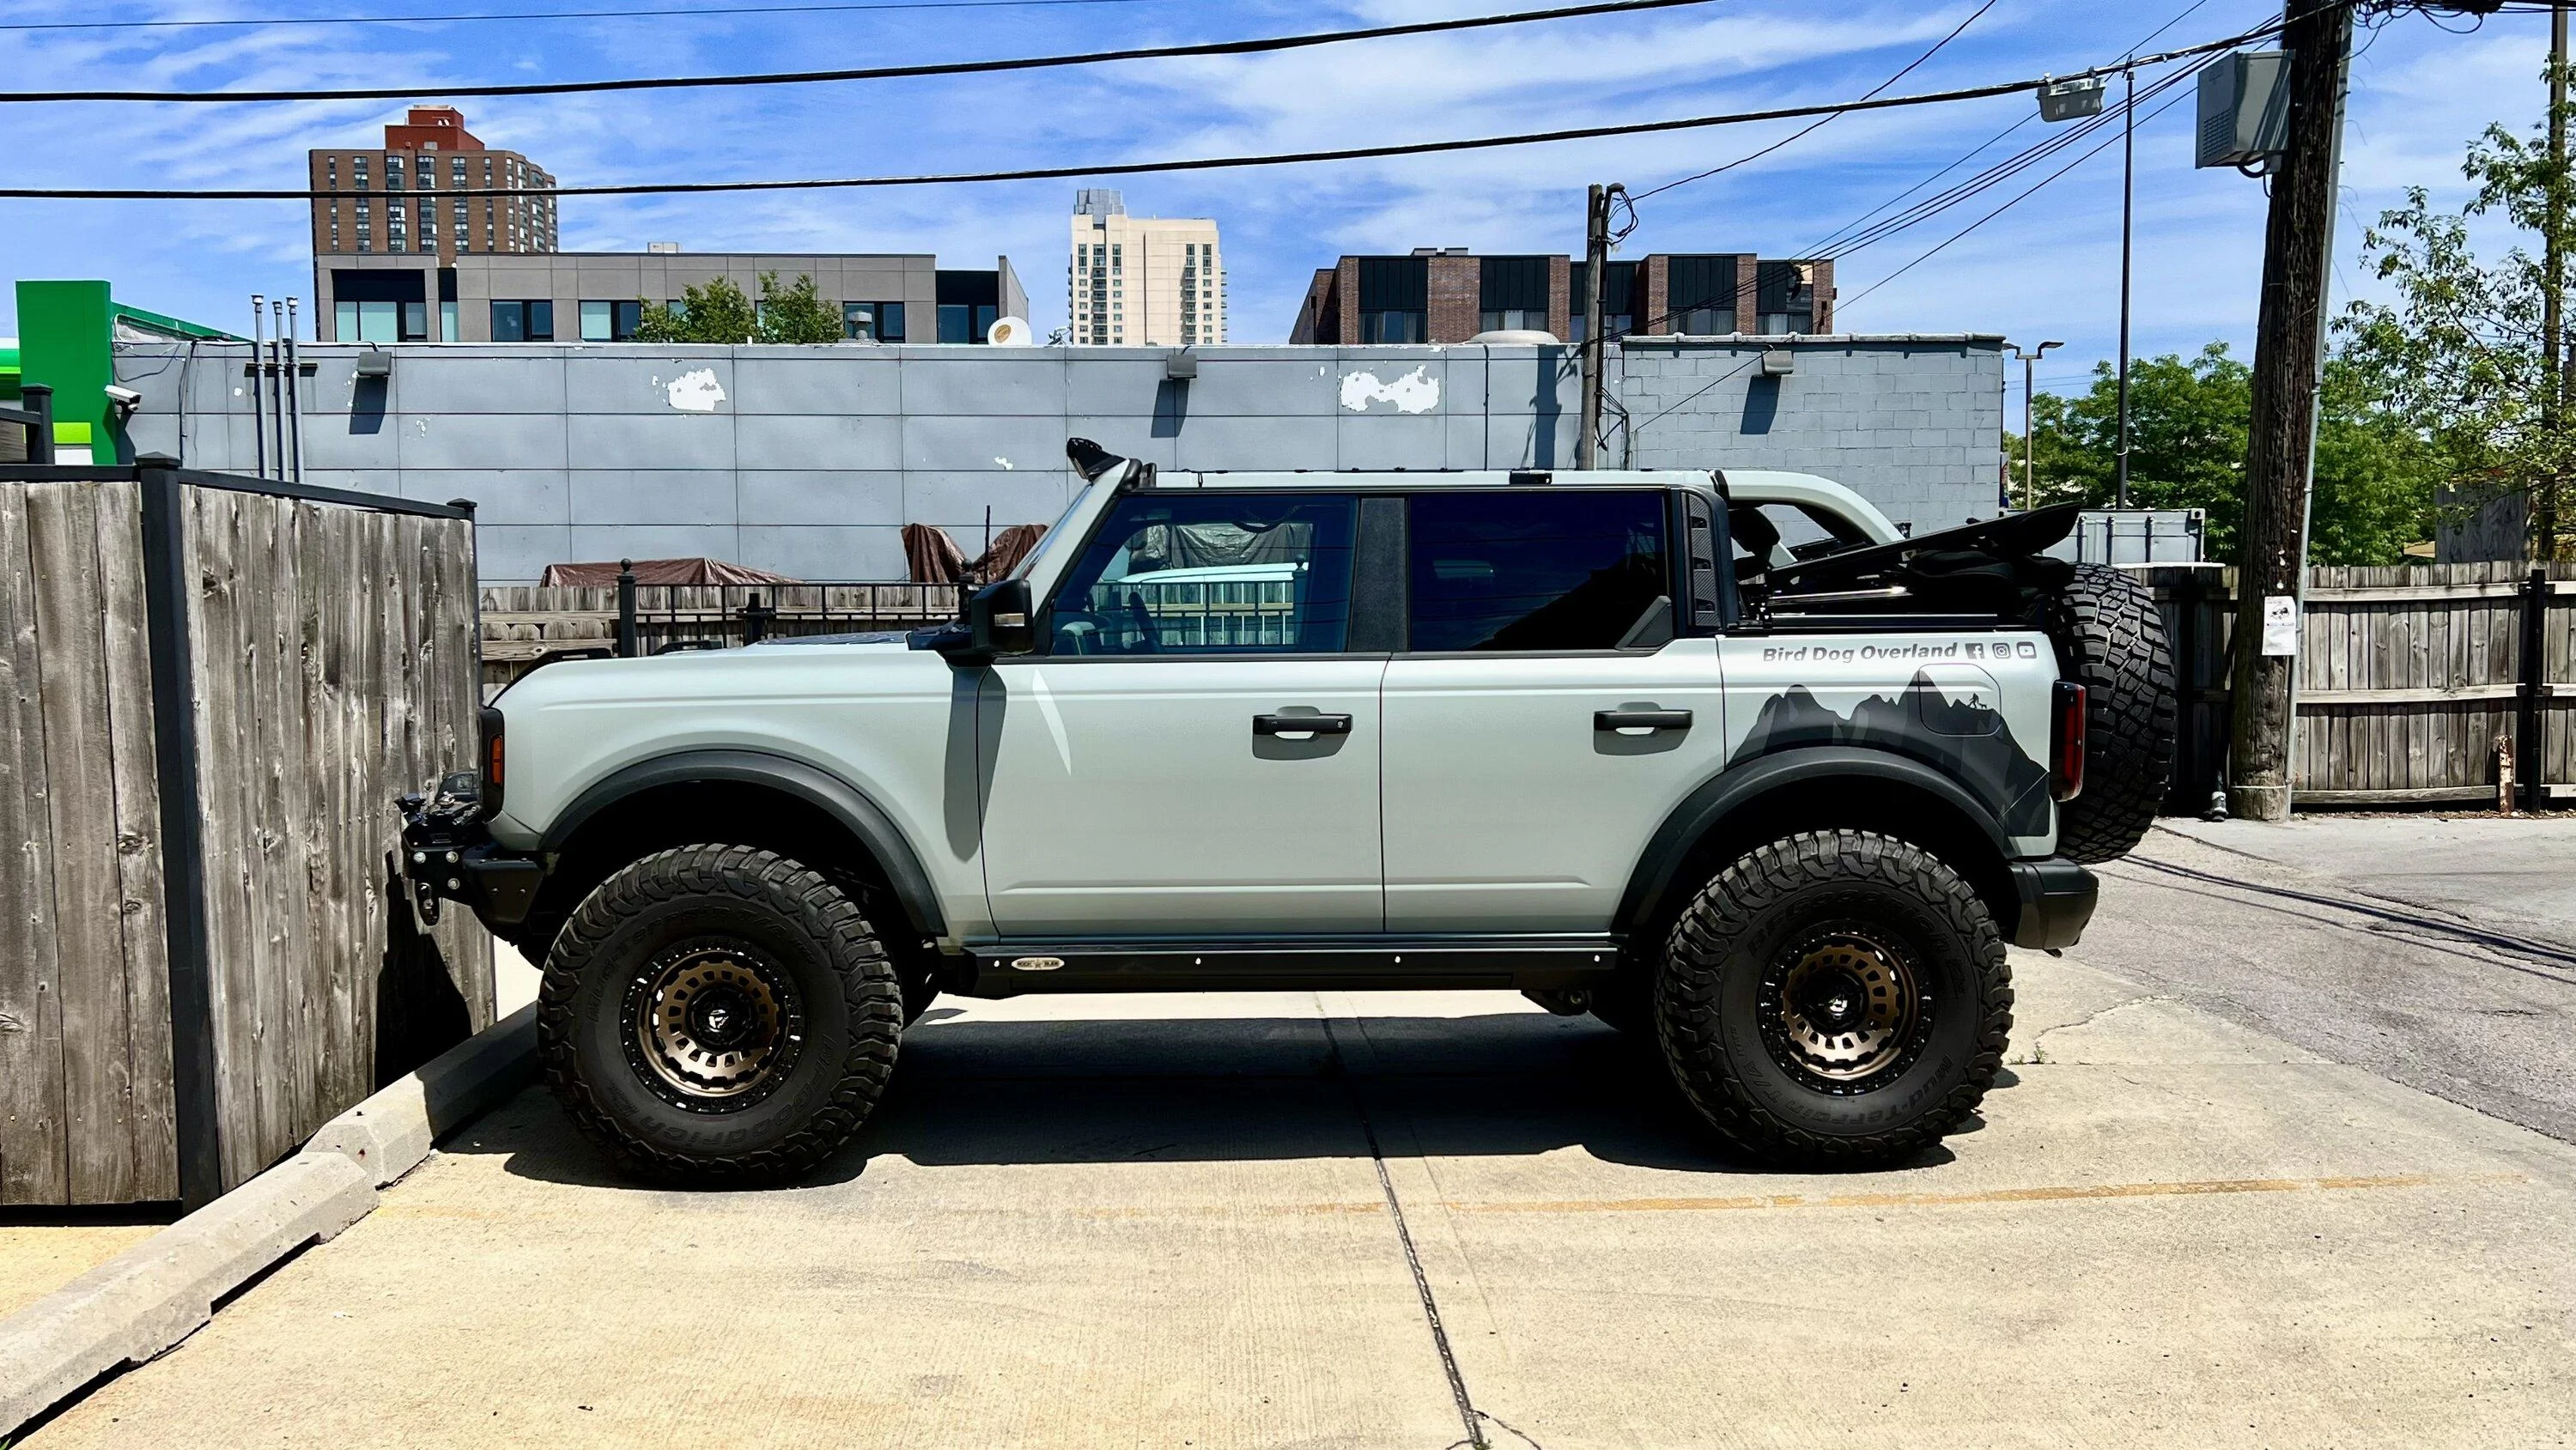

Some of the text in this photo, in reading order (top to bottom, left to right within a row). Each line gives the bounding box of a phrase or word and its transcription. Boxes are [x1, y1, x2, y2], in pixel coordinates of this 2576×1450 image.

[1763, 642, 1959, 663] Bird Dog Overland
